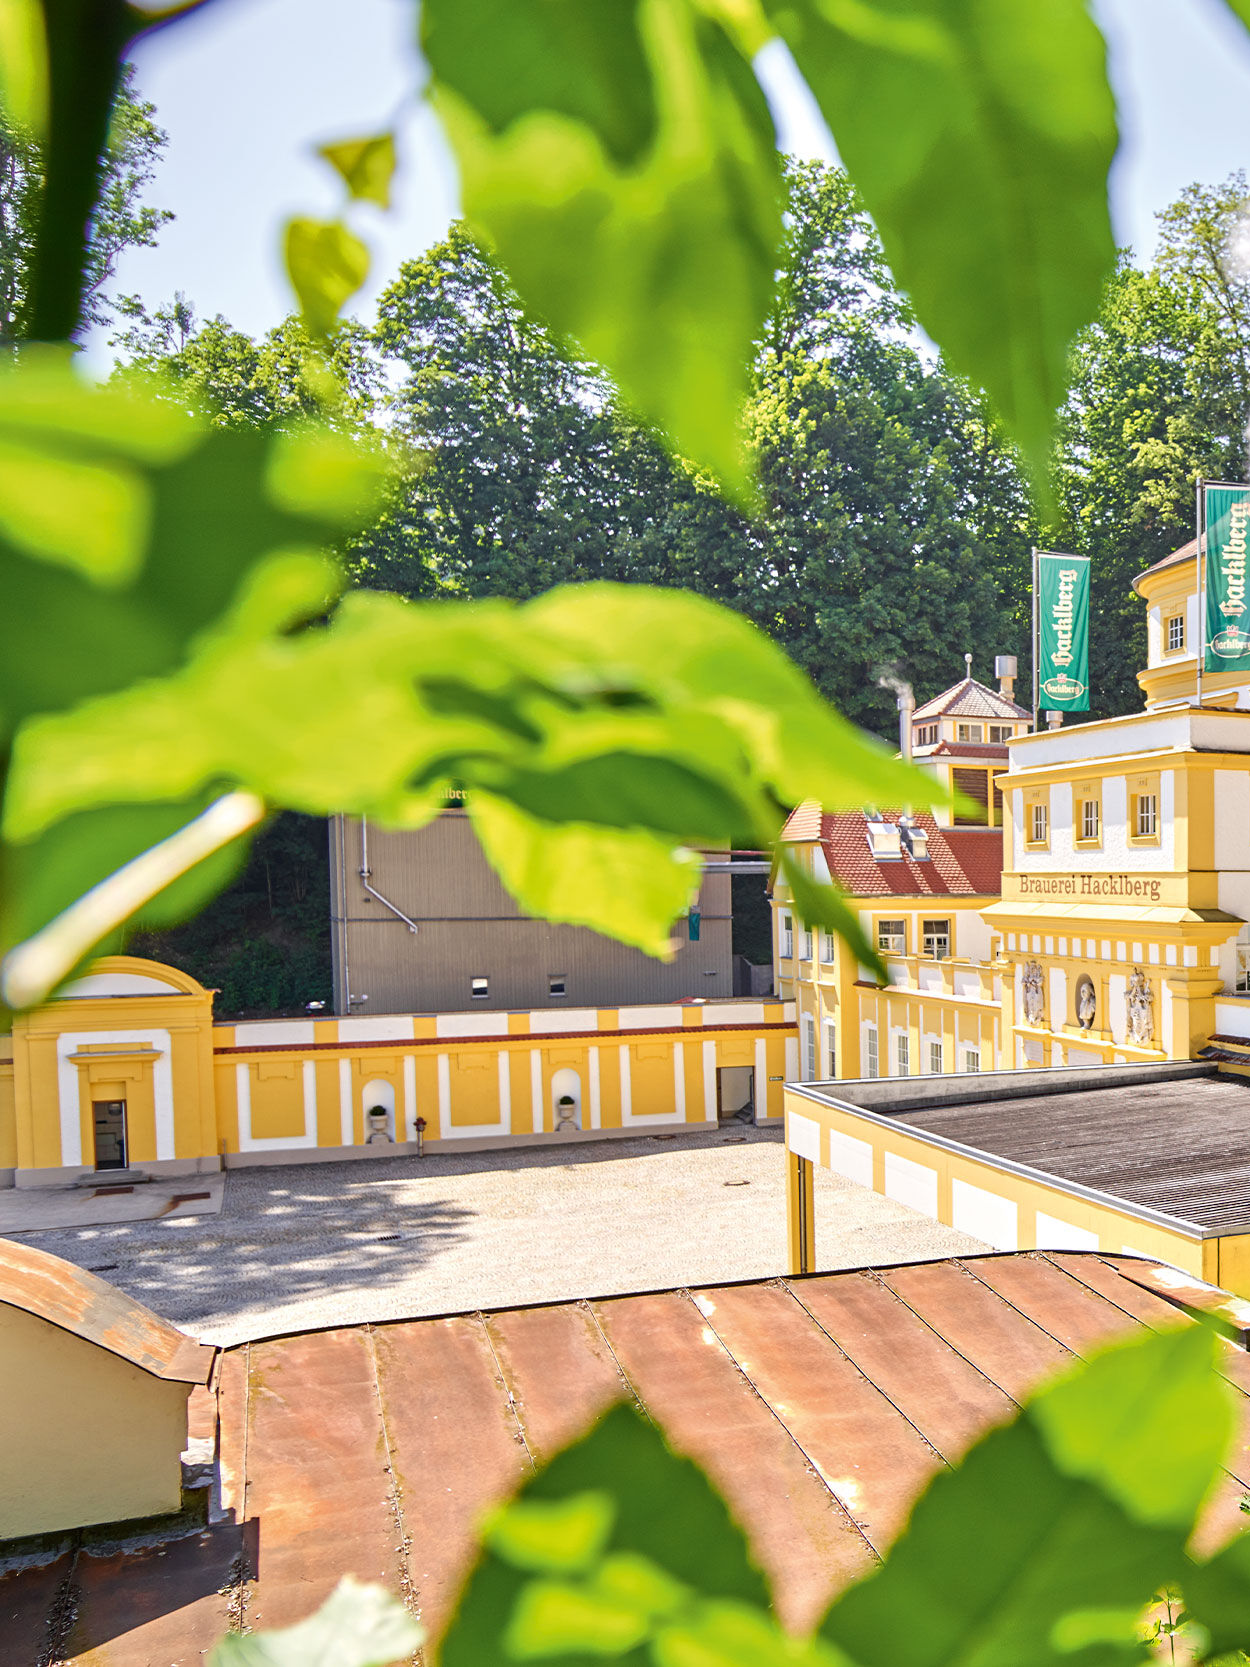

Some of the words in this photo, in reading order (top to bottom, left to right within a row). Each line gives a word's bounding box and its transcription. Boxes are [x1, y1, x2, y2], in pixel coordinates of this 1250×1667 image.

[1051, 568, 1078, 667] Hacklberg
[1019, 874, 1076, 894] Brauerei
[1080, 874, 1161, 901] Hacklberg
